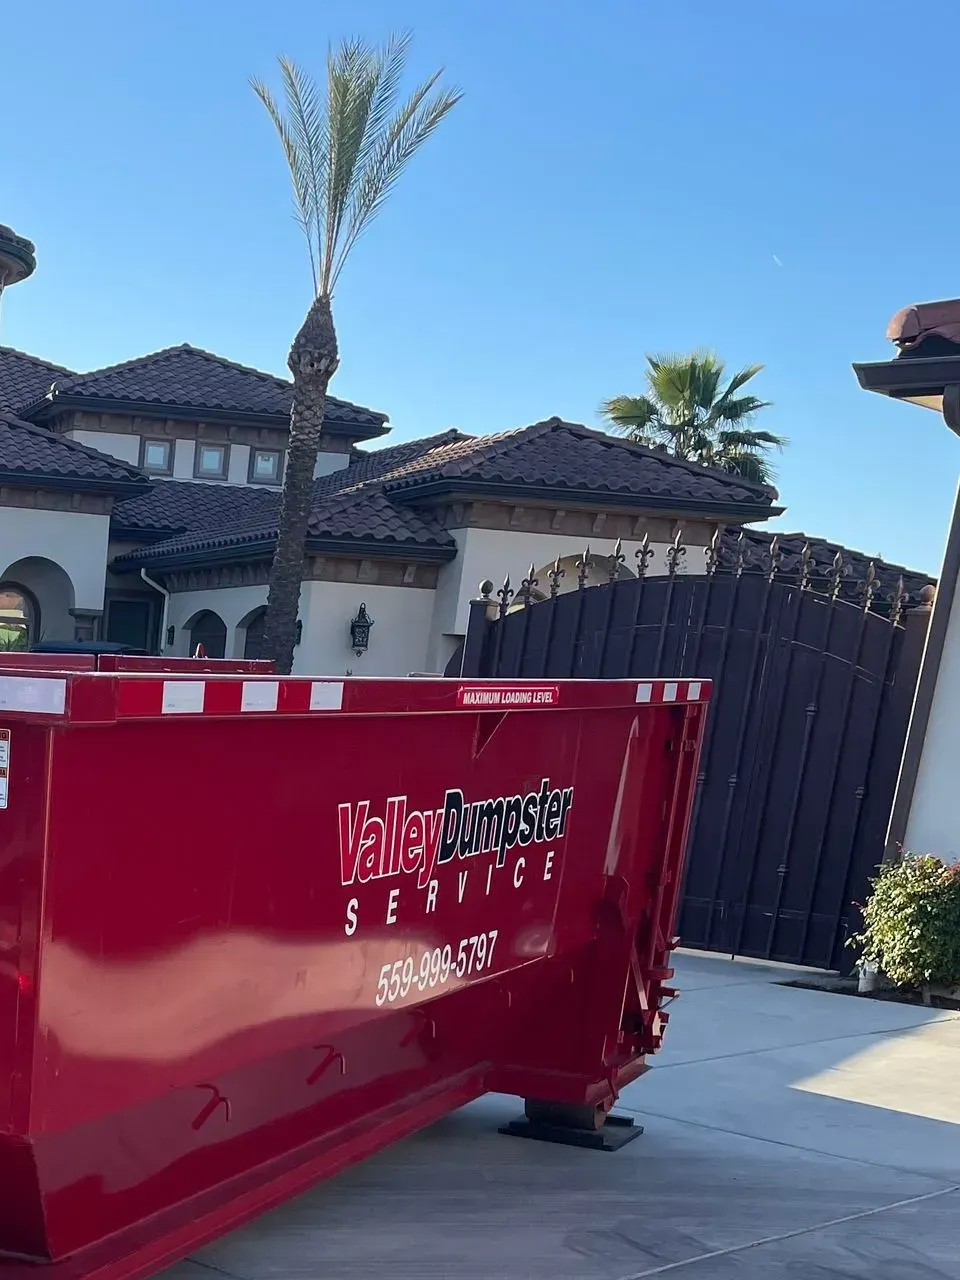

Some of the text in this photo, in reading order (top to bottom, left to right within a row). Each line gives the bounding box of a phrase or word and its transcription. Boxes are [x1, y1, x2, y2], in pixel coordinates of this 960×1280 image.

[463, 691, 554, 704] MAXIMUM LOADING LEVEL
[345, 851, 554, 936] SERVICE
[375, 930, 499, 1007] 559-999-5797
